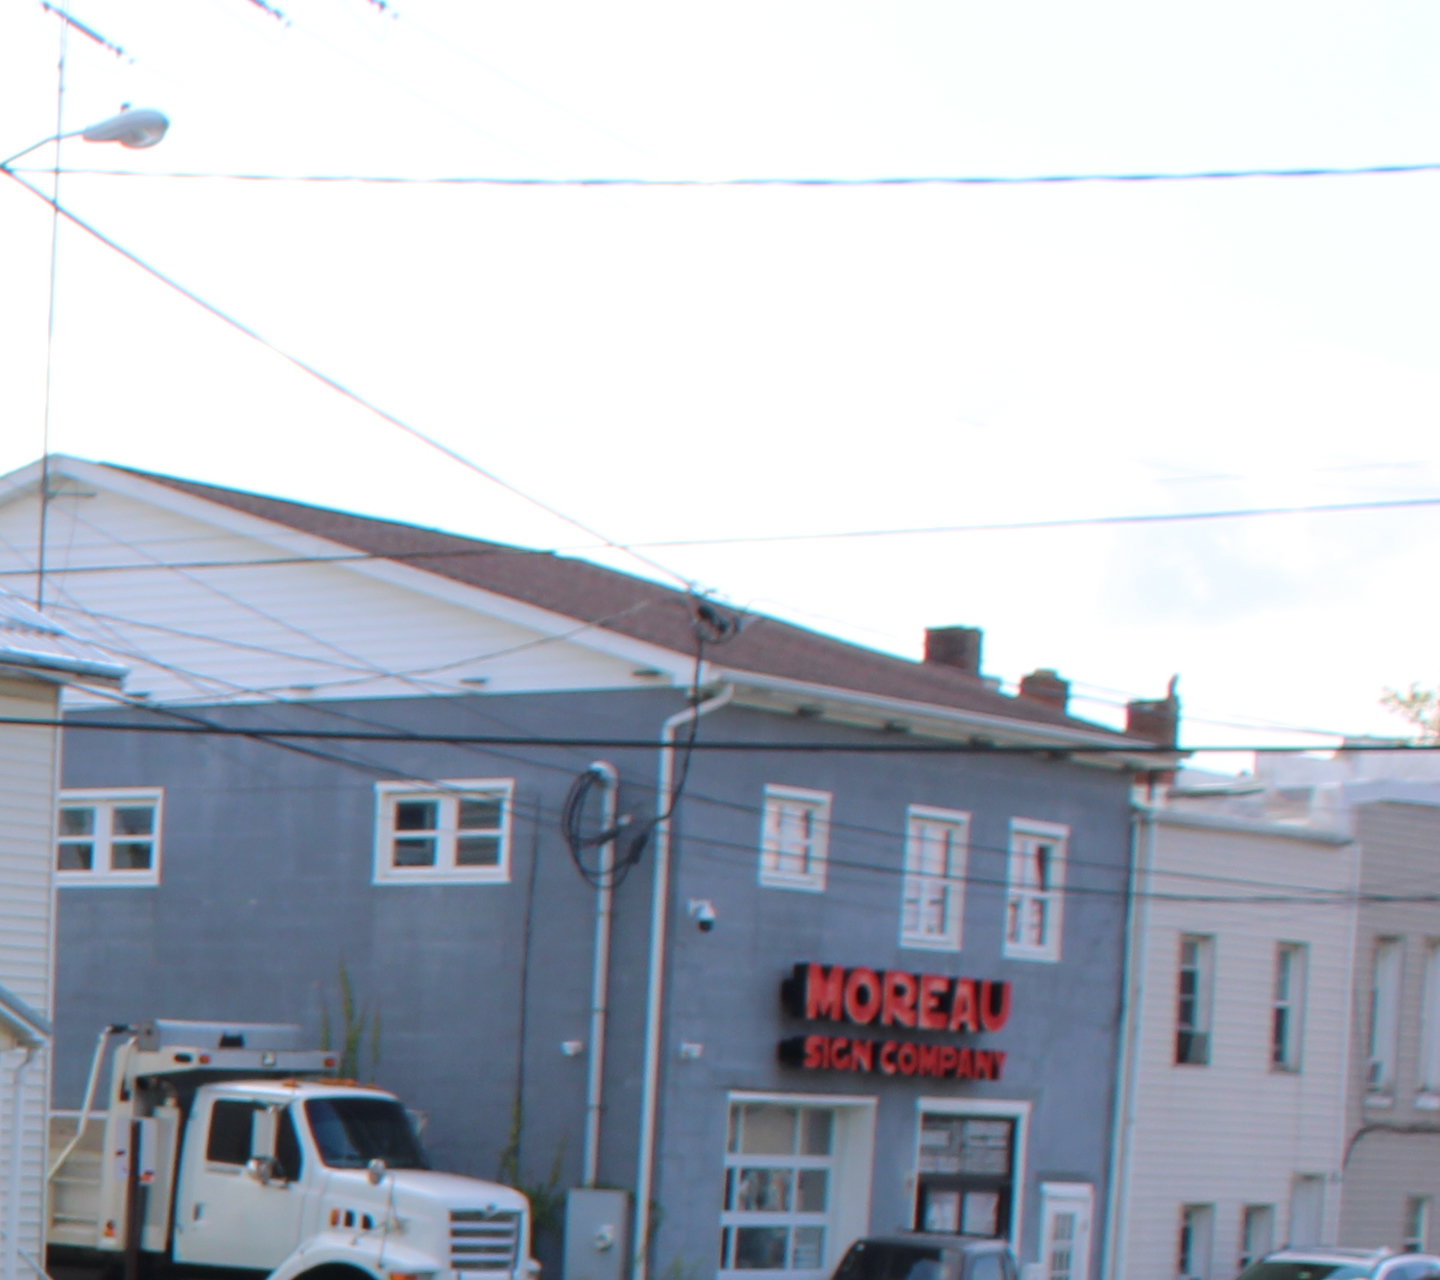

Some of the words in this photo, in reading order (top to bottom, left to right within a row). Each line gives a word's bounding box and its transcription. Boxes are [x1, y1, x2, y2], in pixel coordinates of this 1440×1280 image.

[805, 962, 1013, 1033] MOREAU
[803, 1034, 873, 1072] SIGN
[880, 1040, 1007, 1081] COMPANY
